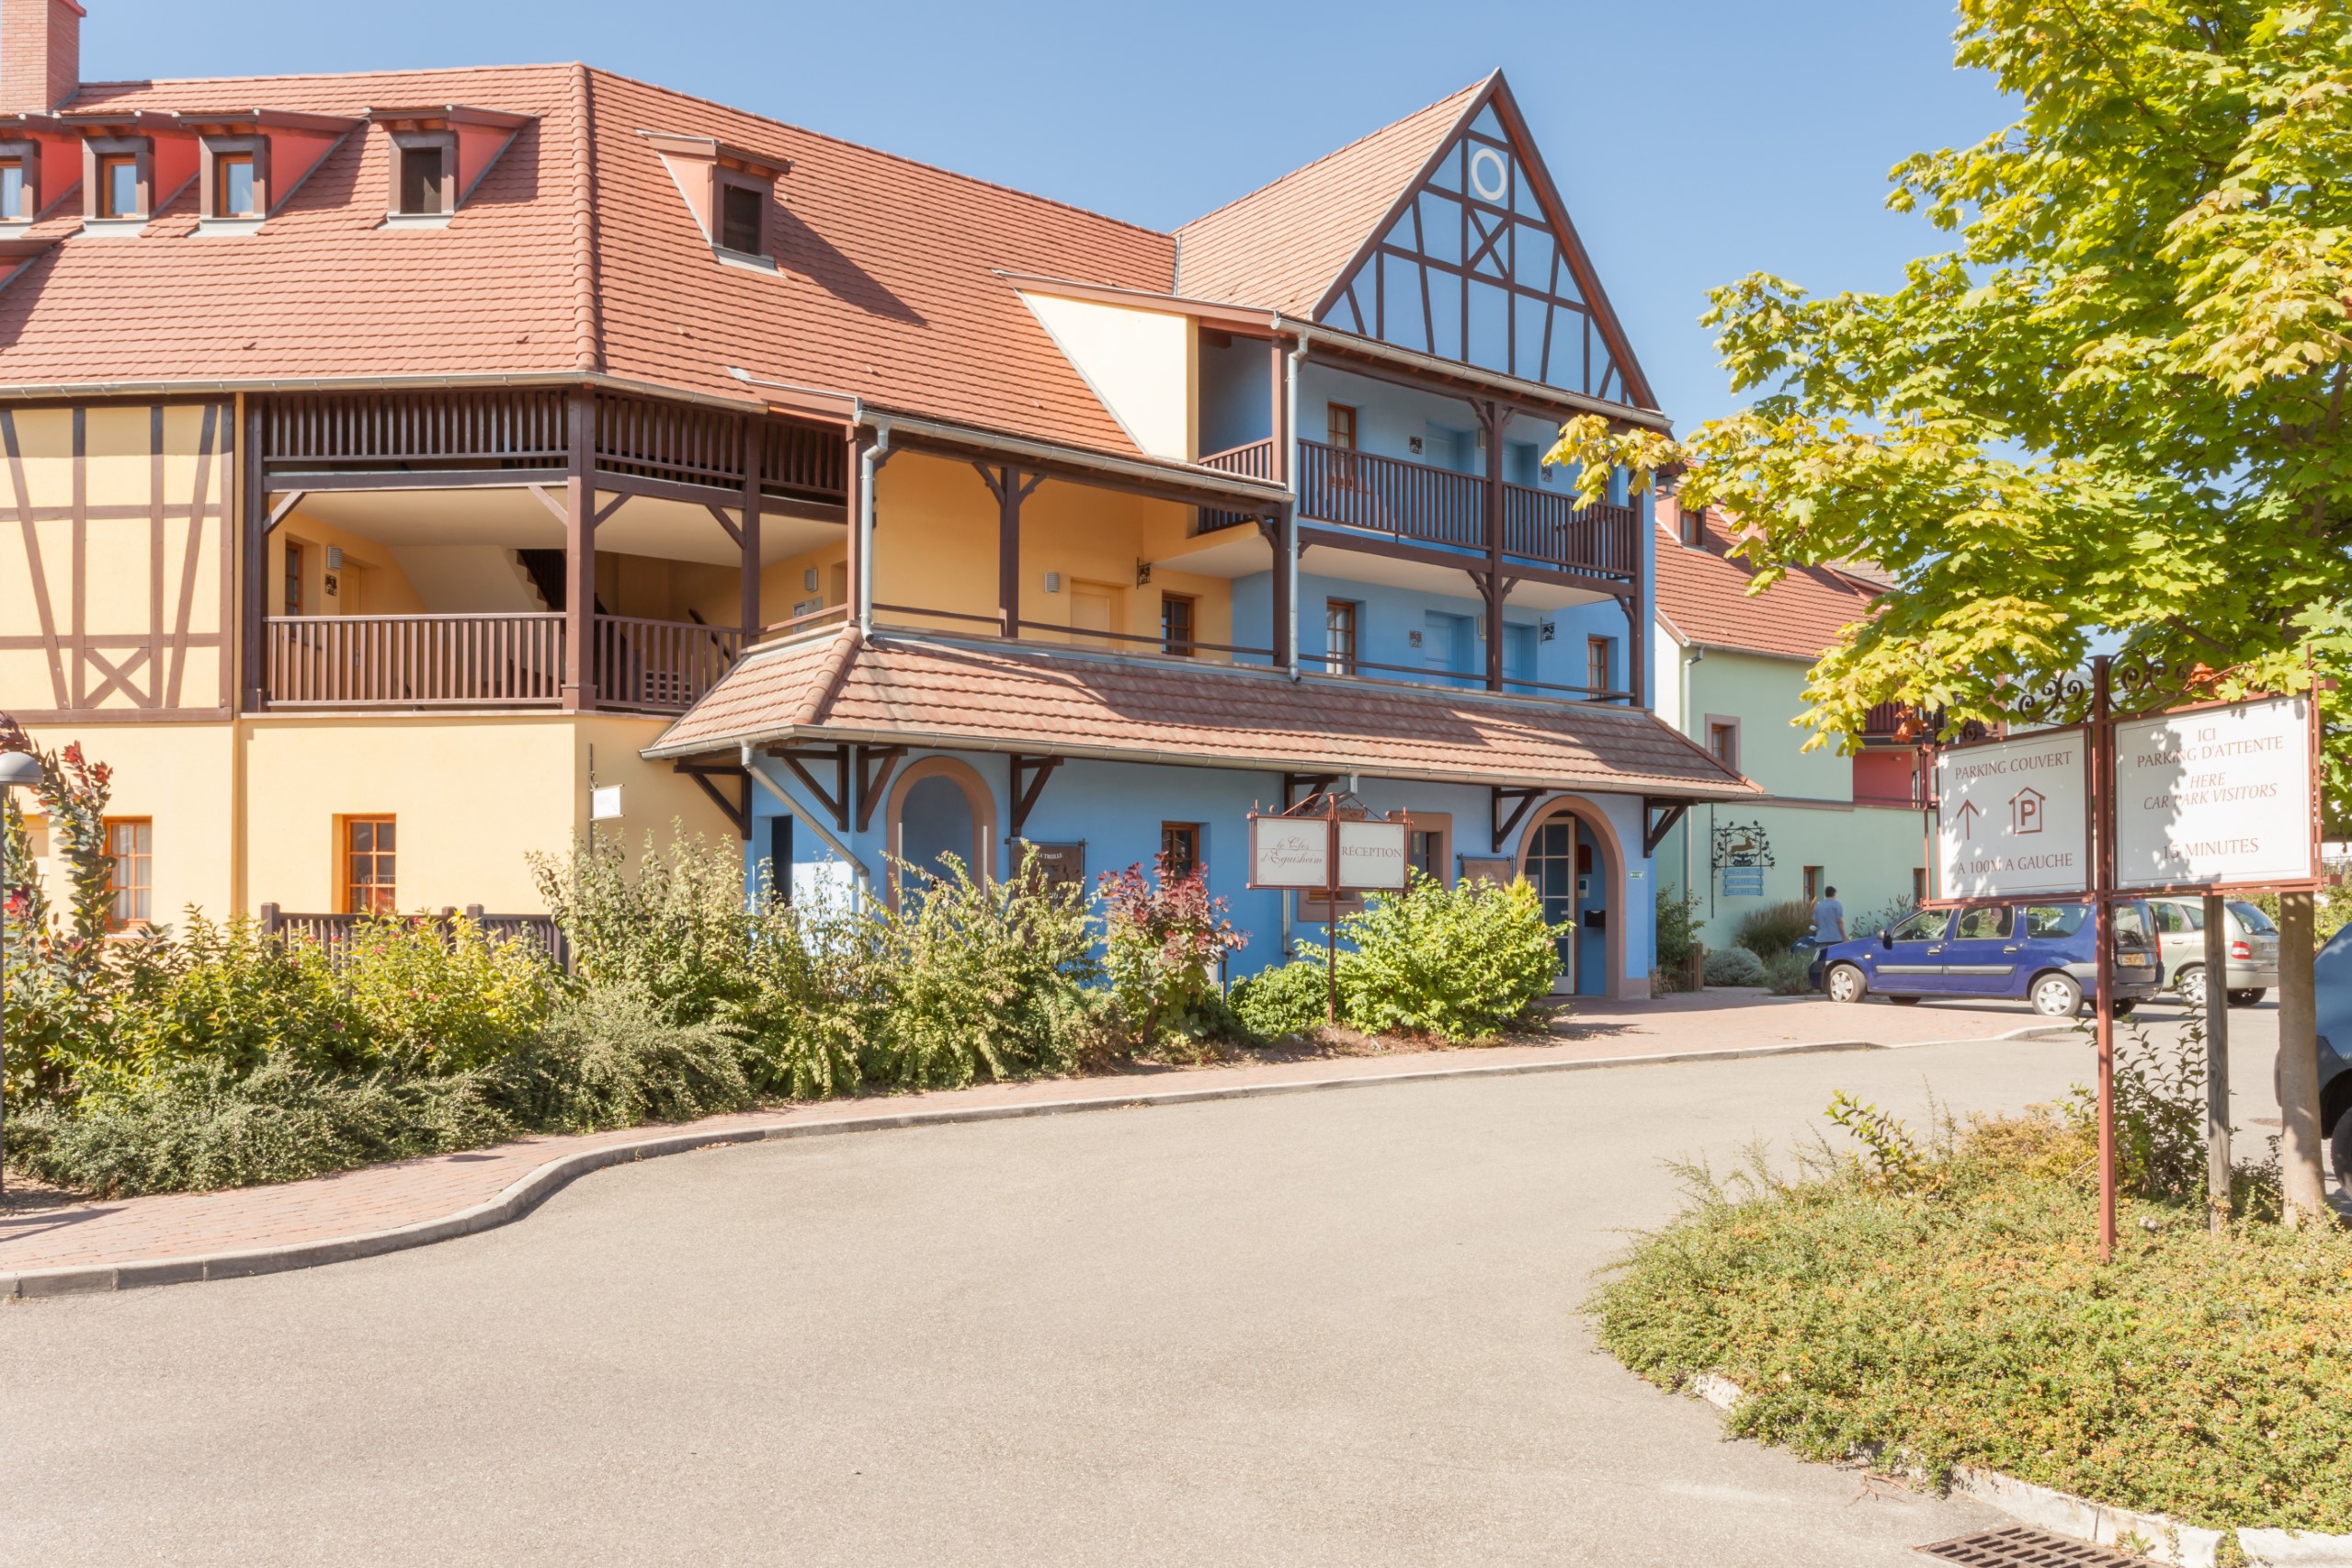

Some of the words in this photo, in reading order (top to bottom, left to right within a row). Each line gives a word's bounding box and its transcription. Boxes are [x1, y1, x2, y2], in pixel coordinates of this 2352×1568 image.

[2198, 728, 2216, 742] ICI
[2137, 746, 2197, 767] PARKING
[2201, 735, 2283, 759] D'ATTENTE
[1955, 761, 2006, 780] PARKING
[2010, 751, 2073, 772] COUVERT
[2189, 772, 2227, 789] HERE
[2143, 795, 2169, 811] CAR
[2173, 790, 2210, 808] PARK
[2213, 782, 2278, 802] VISITORS
[2020, 799, 2036, 826] P
[1288, 835, 1310, 851] Clos
[1341, 844, 1402, 858] RÉCEPTION
[2163, 845, 2180, 859] 15
[2185, 837, 2259, 857] MINUTES
[1957, 862, 1966, 874] A
[2005, 858, 2015, 871] A
[2017, 853, 2074, 870] GAUCHE
